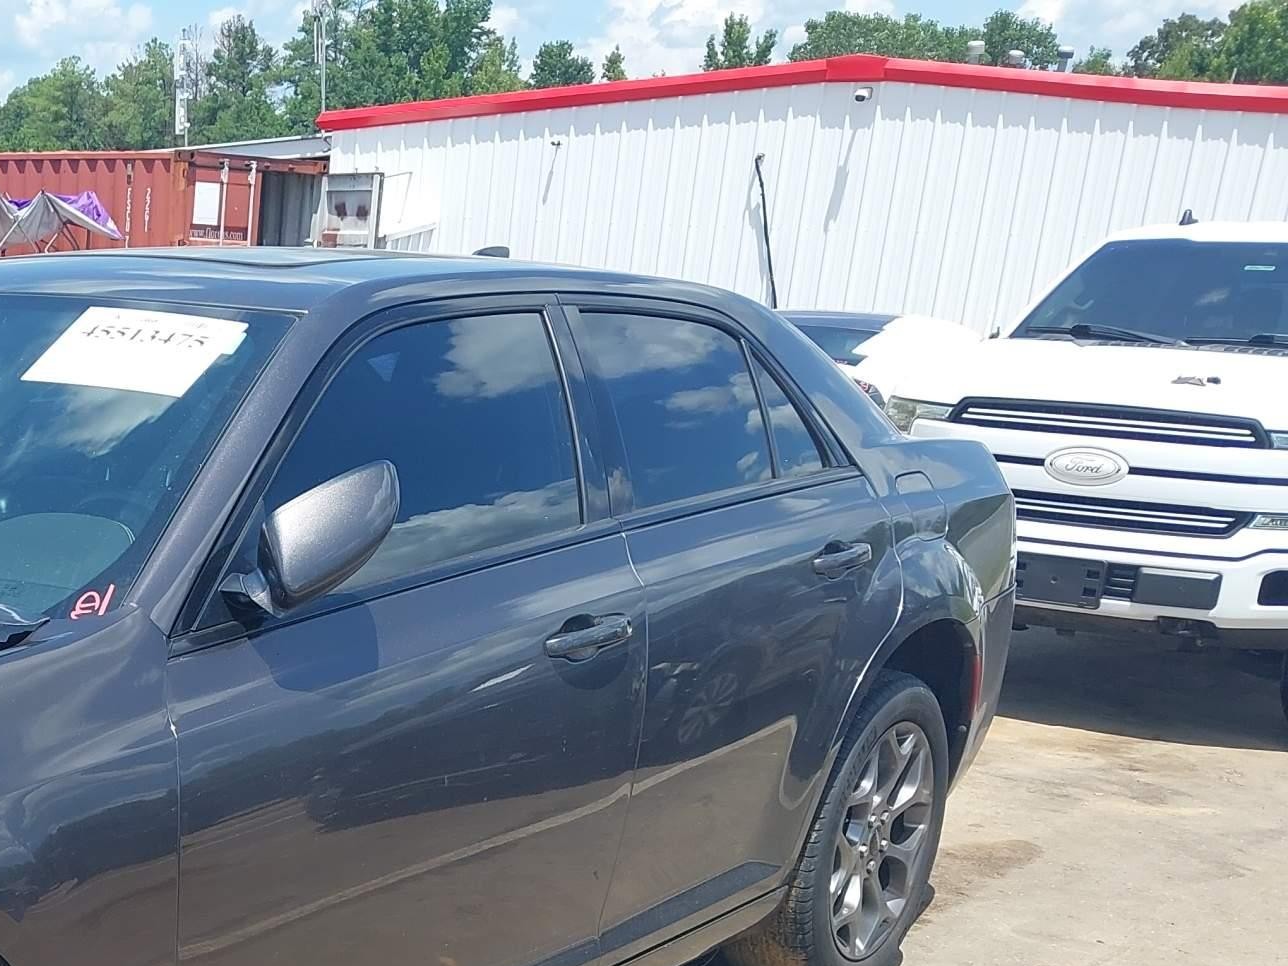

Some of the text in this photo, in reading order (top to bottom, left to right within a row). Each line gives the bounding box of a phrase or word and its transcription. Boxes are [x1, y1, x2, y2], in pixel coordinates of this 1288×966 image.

[144, 187, 152, 233] 2261
[80, 324, 210, 349] 45513475
[1064, 455, 1104, 474] Ford
